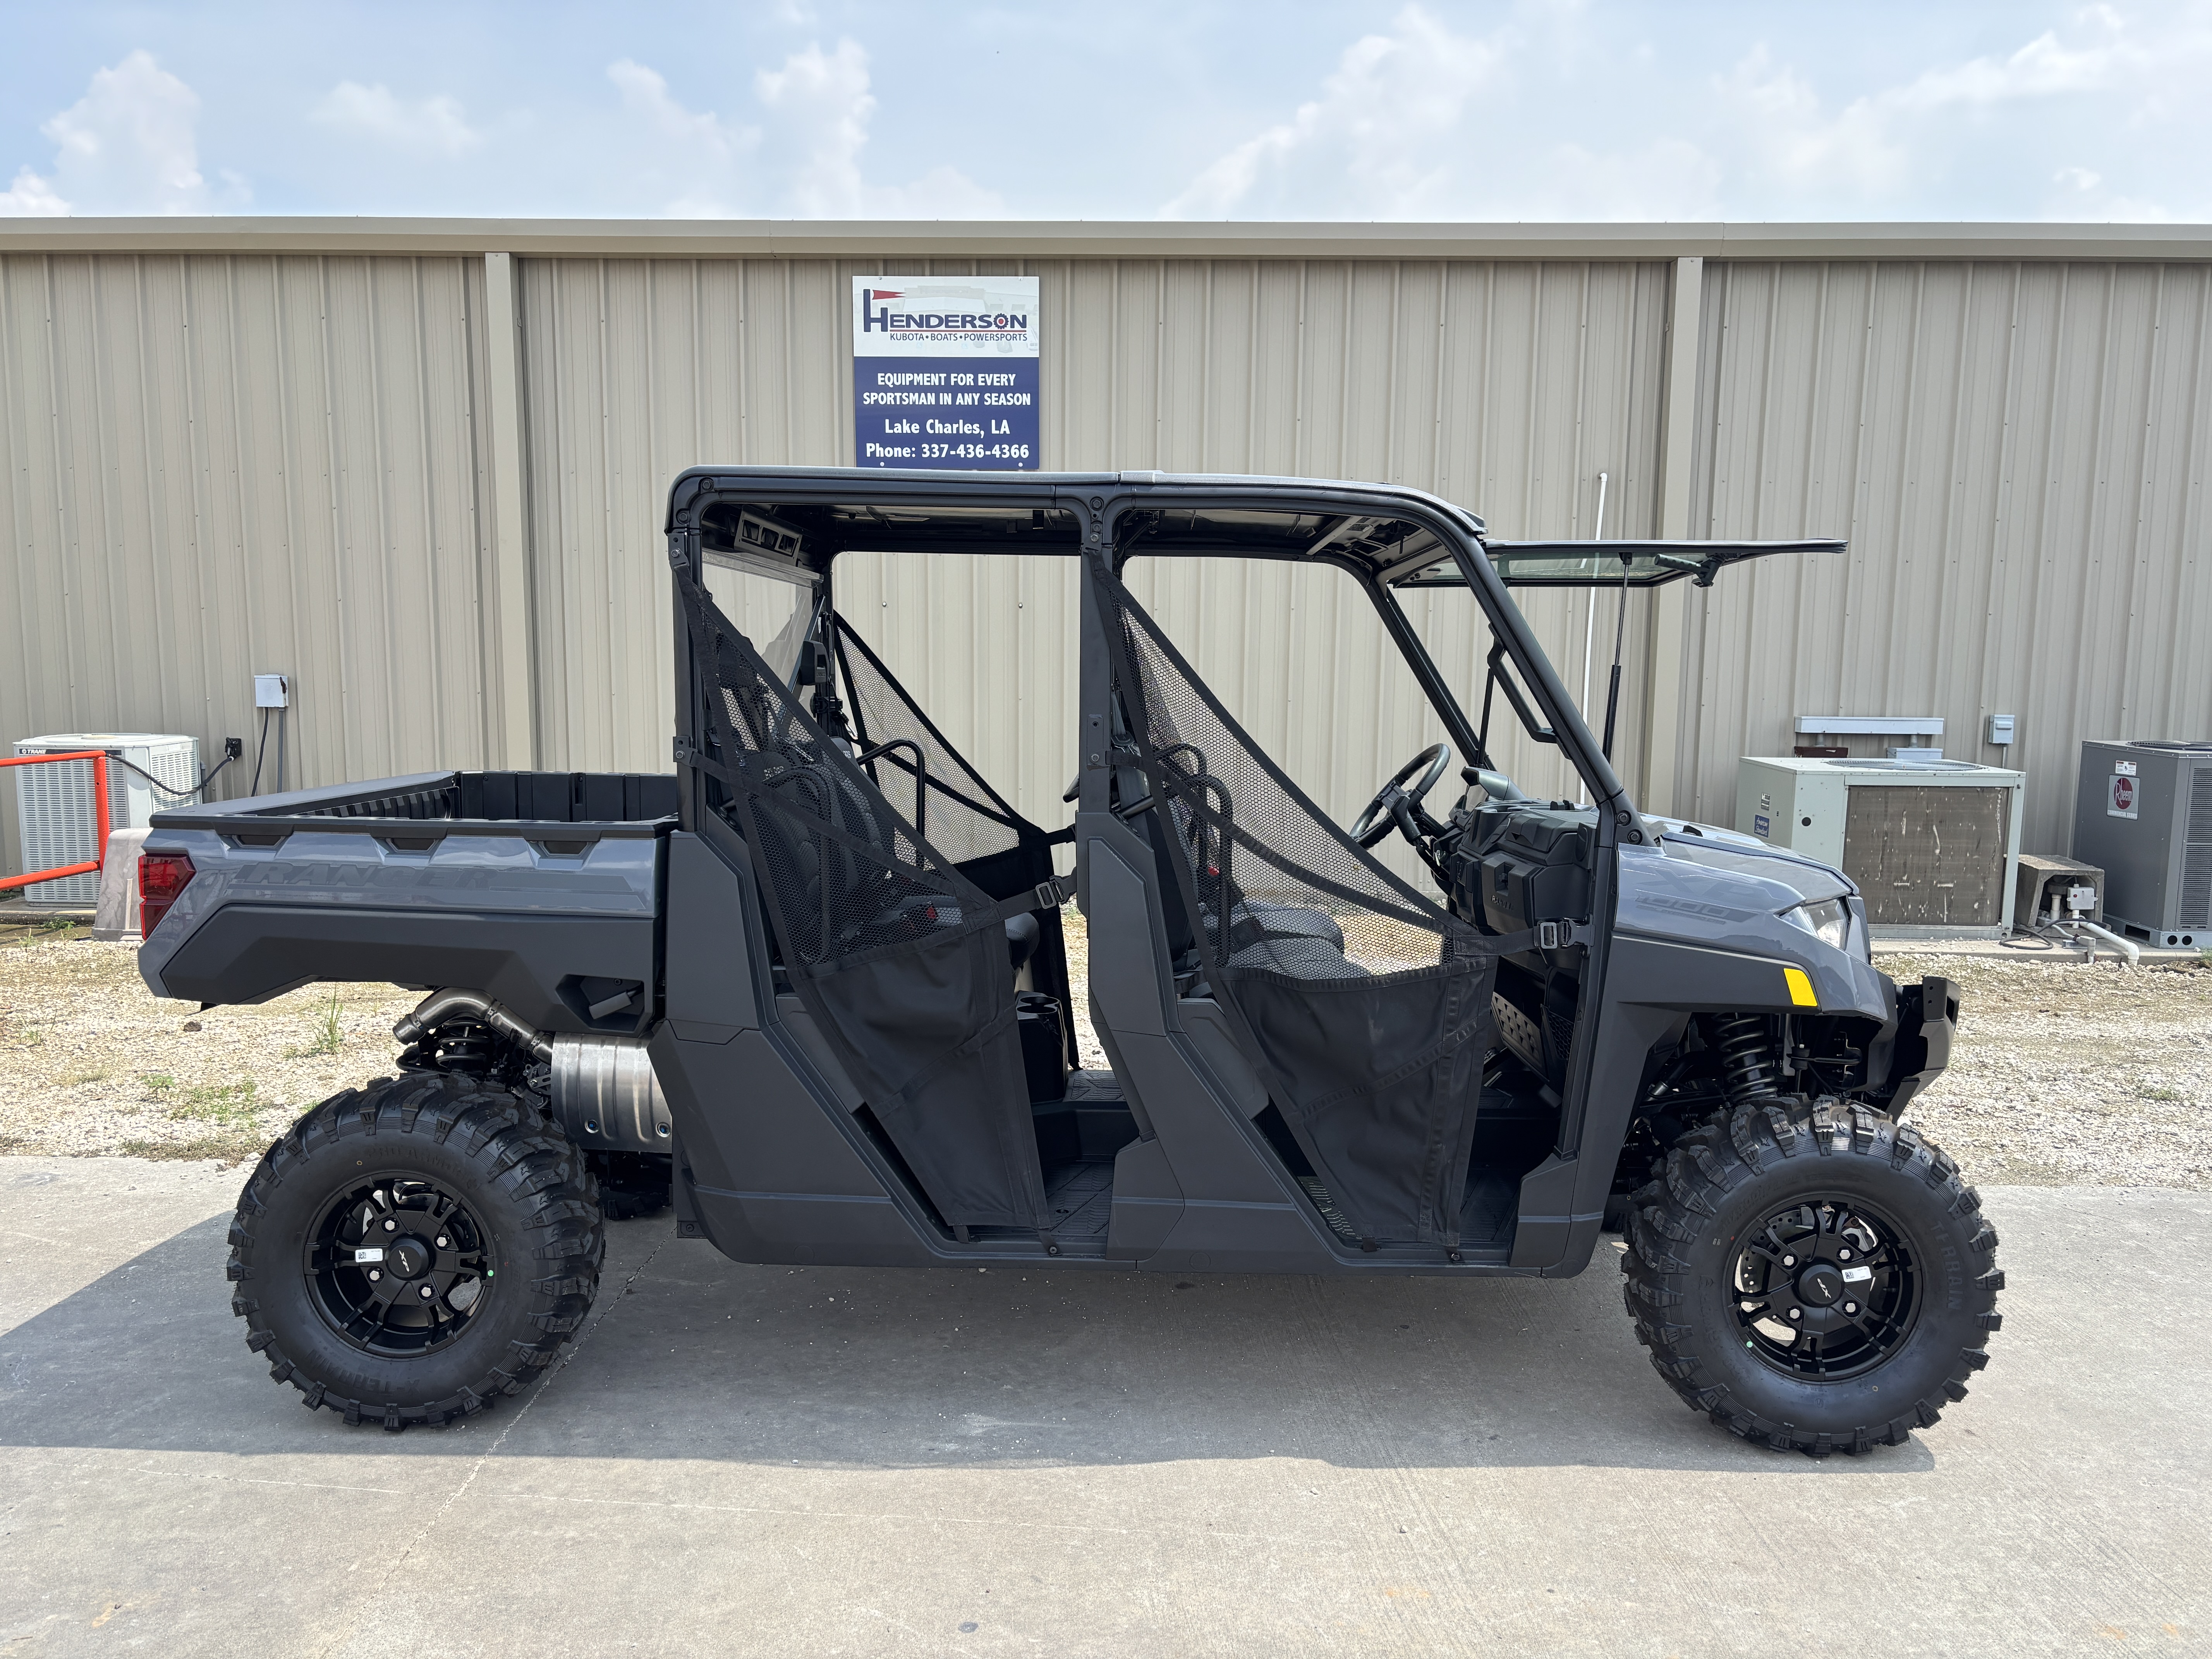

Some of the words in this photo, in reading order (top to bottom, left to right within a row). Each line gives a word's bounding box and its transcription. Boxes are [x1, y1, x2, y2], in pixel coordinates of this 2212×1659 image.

[863, 289, 1027, 332] HENDERSON
[964, 333, 1027, 342] POWERSPORTS
[877, 373, 946, 388] EQUIPMENT
[951, 373, 974, 386] FOR
[978, 374, 1016, 386] EVERY
[863, 392, 935, 405] SPORTSMAN
[939, 393, 952, 405] IN
[955, 393, 980, 405] ANY
[984, 393, 1031, 406] SEASON
[885, 419, 920, 434] Lake
[926, 419, 985, 439] Charles,
[991, 419, 1010, 434] LA
[866, 443, 916, 458] Phone:
[921, 444, 1029, 458] 337-436-4366
[2116, 778, 2132, 805] Rheem
[245, 861, 499, 888] RANGER
